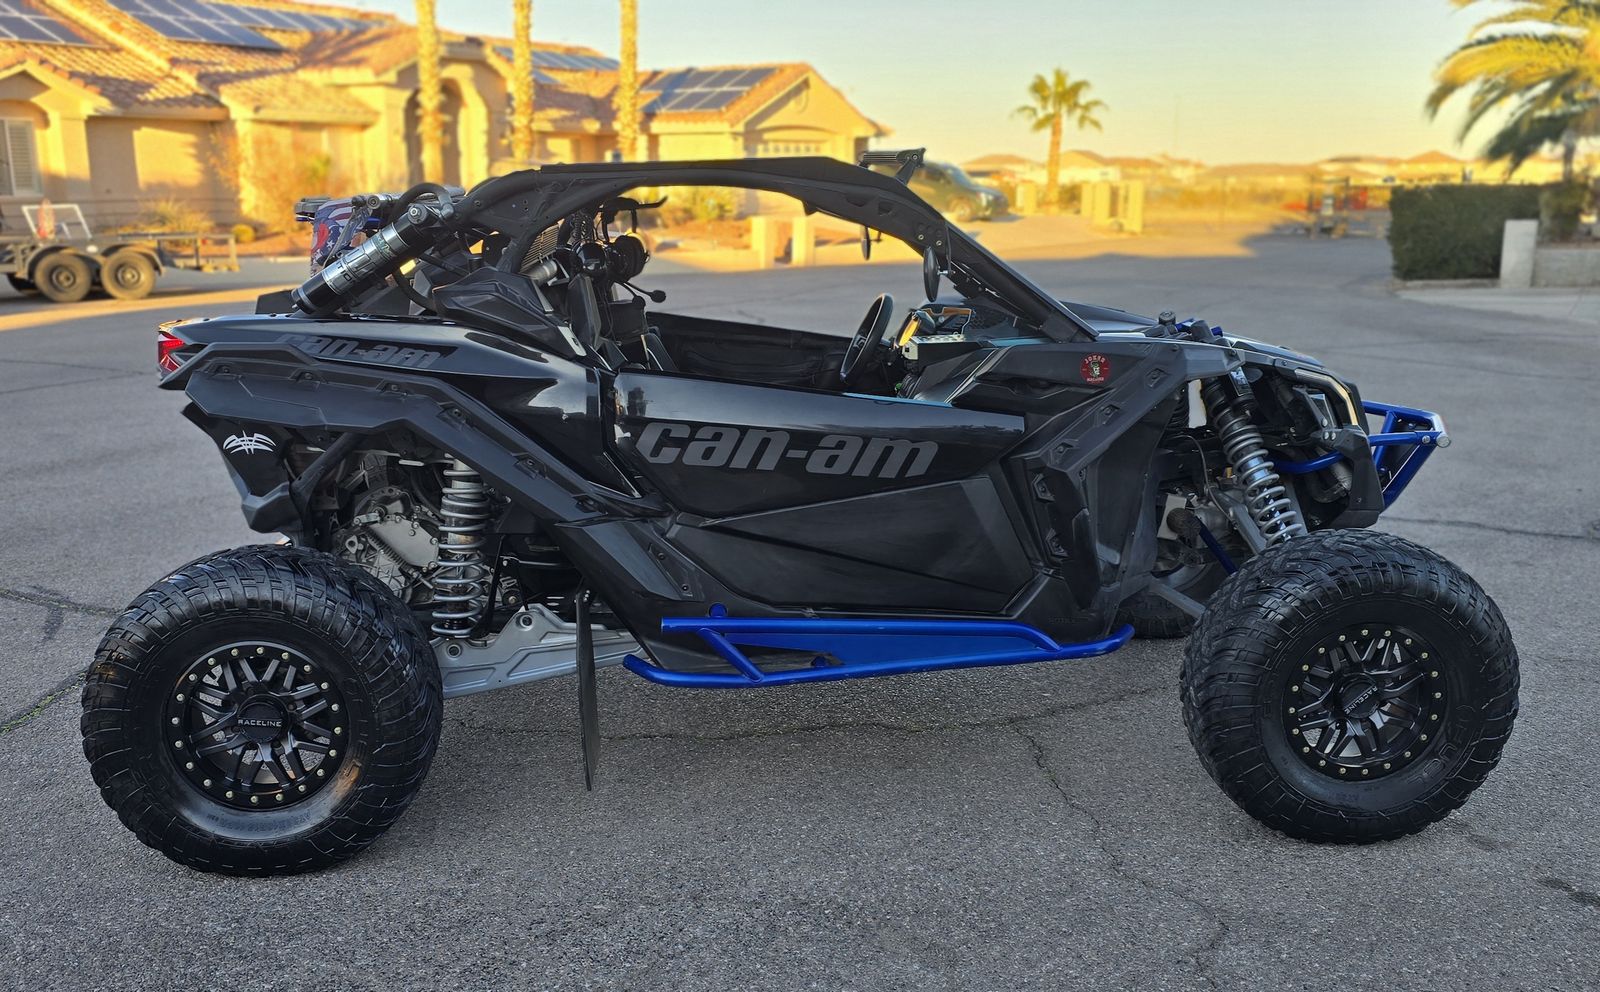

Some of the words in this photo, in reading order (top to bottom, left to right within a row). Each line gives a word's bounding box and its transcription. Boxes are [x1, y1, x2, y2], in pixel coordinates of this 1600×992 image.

[635, 421, 939, 479] can-am
[1344, 685, 1378, 715] RACELINE
[237, 718, 283, 728] RACELINE
